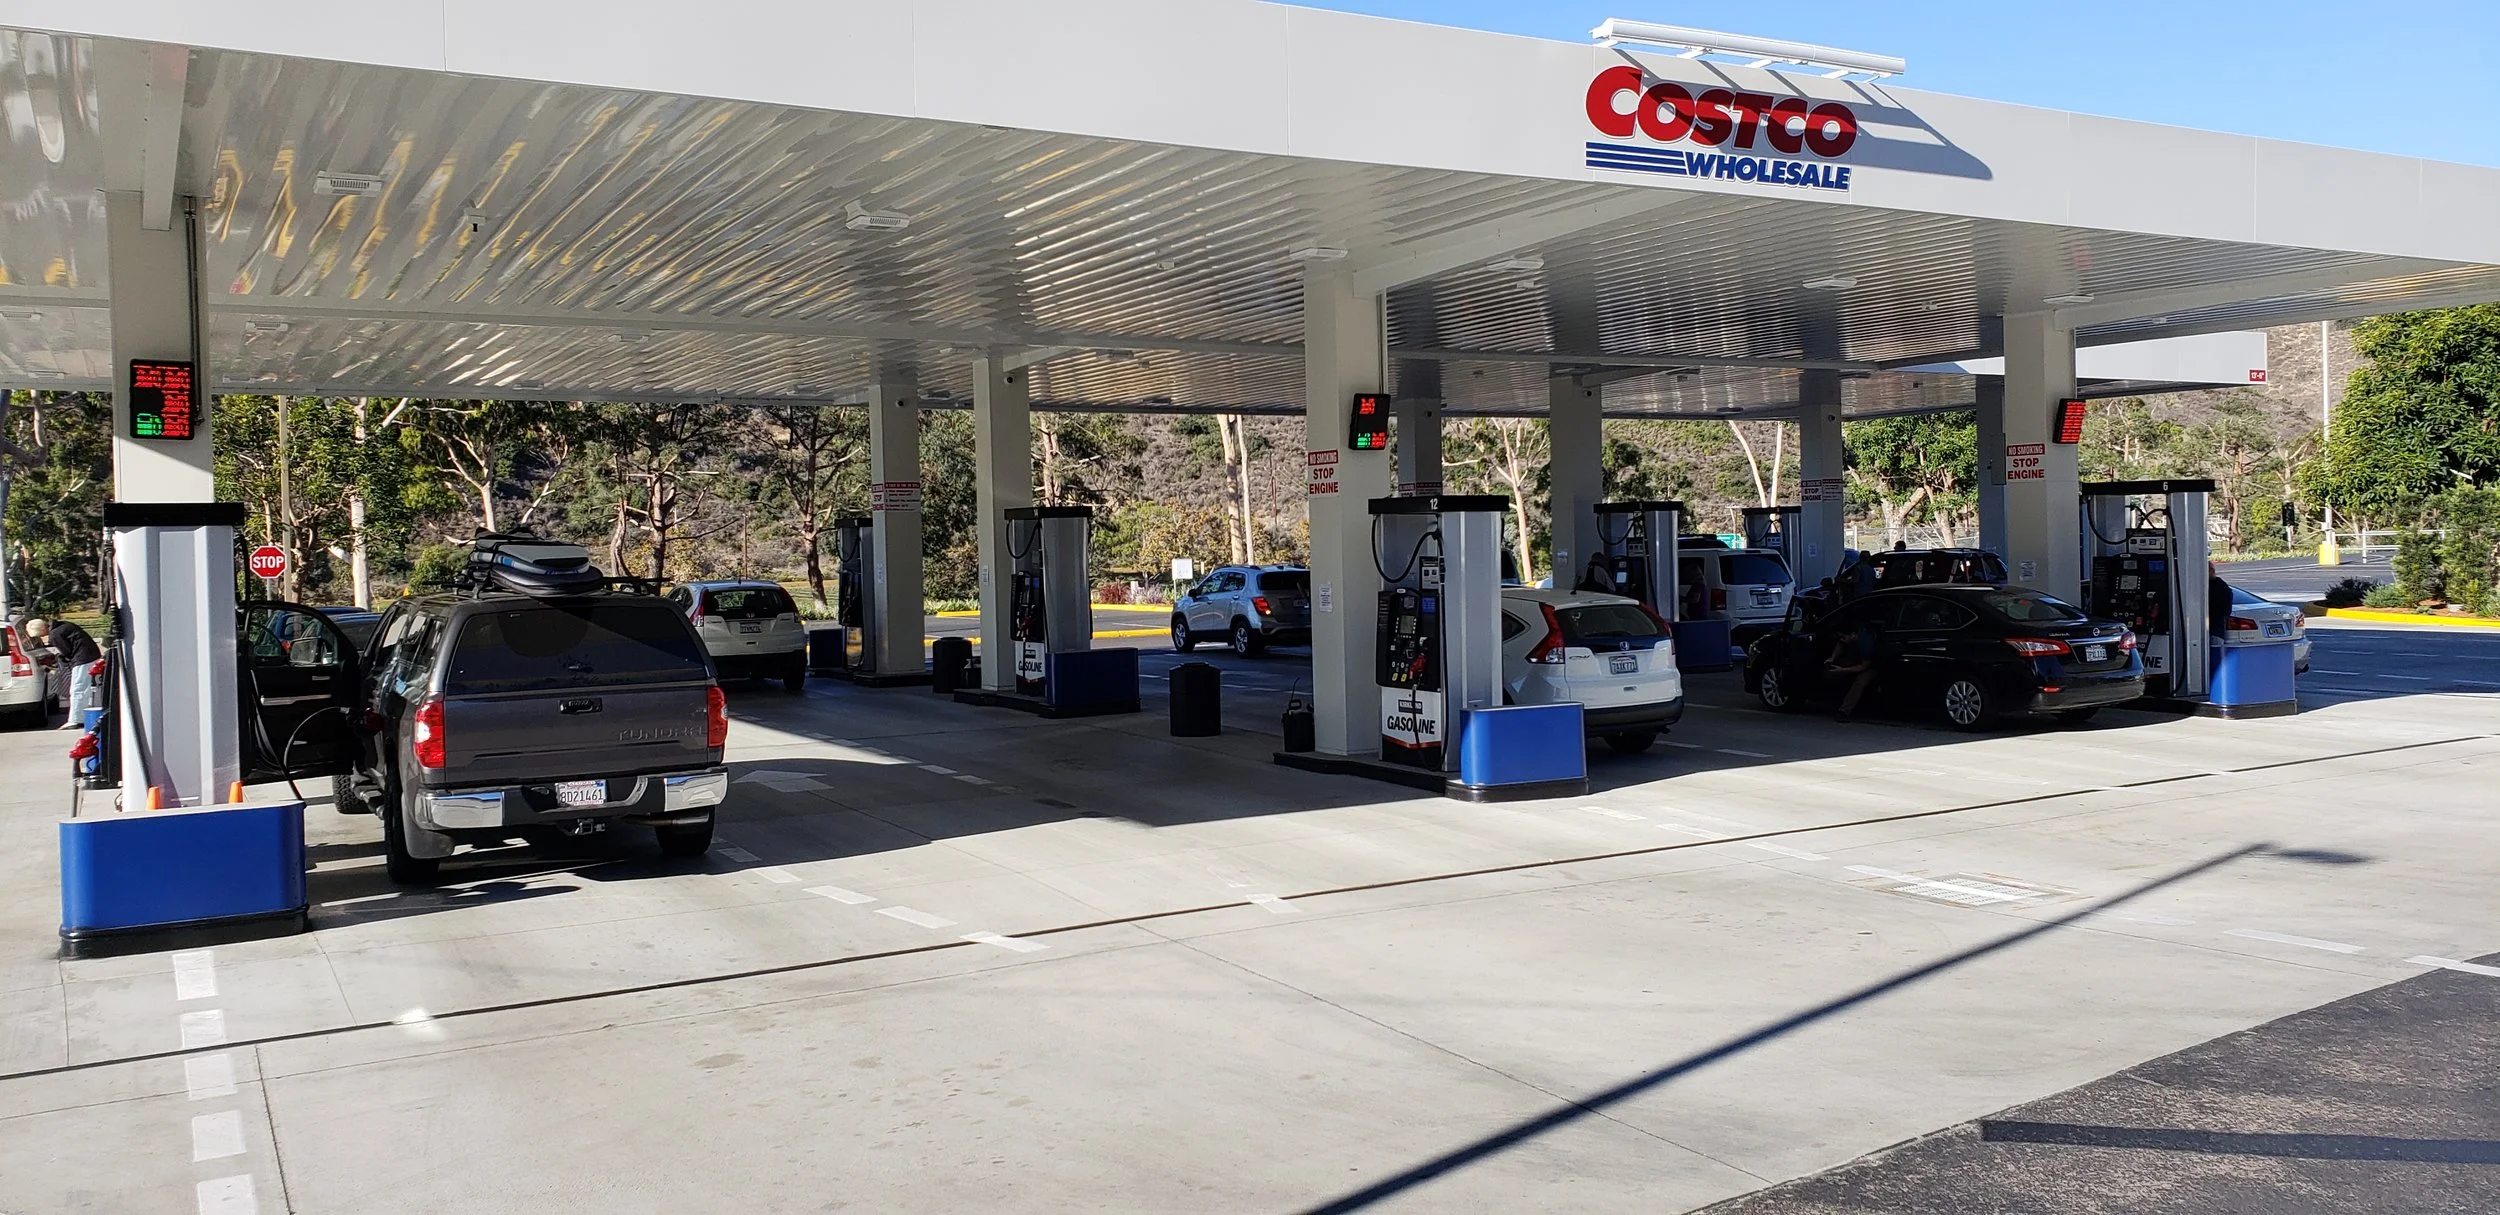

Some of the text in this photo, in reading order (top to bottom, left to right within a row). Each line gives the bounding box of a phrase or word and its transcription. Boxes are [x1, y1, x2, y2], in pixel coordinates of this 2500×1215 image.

[1585, 65, 1858, 159] COSTCO
[1684, 151, 1851, 191] WHOLESALE
[2017, 445, 2044, 455] SMOKING
[2012, 457, 2039, 468] STOP
[1313, 467, 1334, 480] STOP
[2007, 468, 2045, 480] ENGINE
[1309, 481, 1339, 495] ENGINE
[2162, 481, 2169, 491] 6
[1429, 498, 1439, 510] 12
[252, 555, 285, 569] STOP
[1018, 660, 1043, 673] GSOLINE
